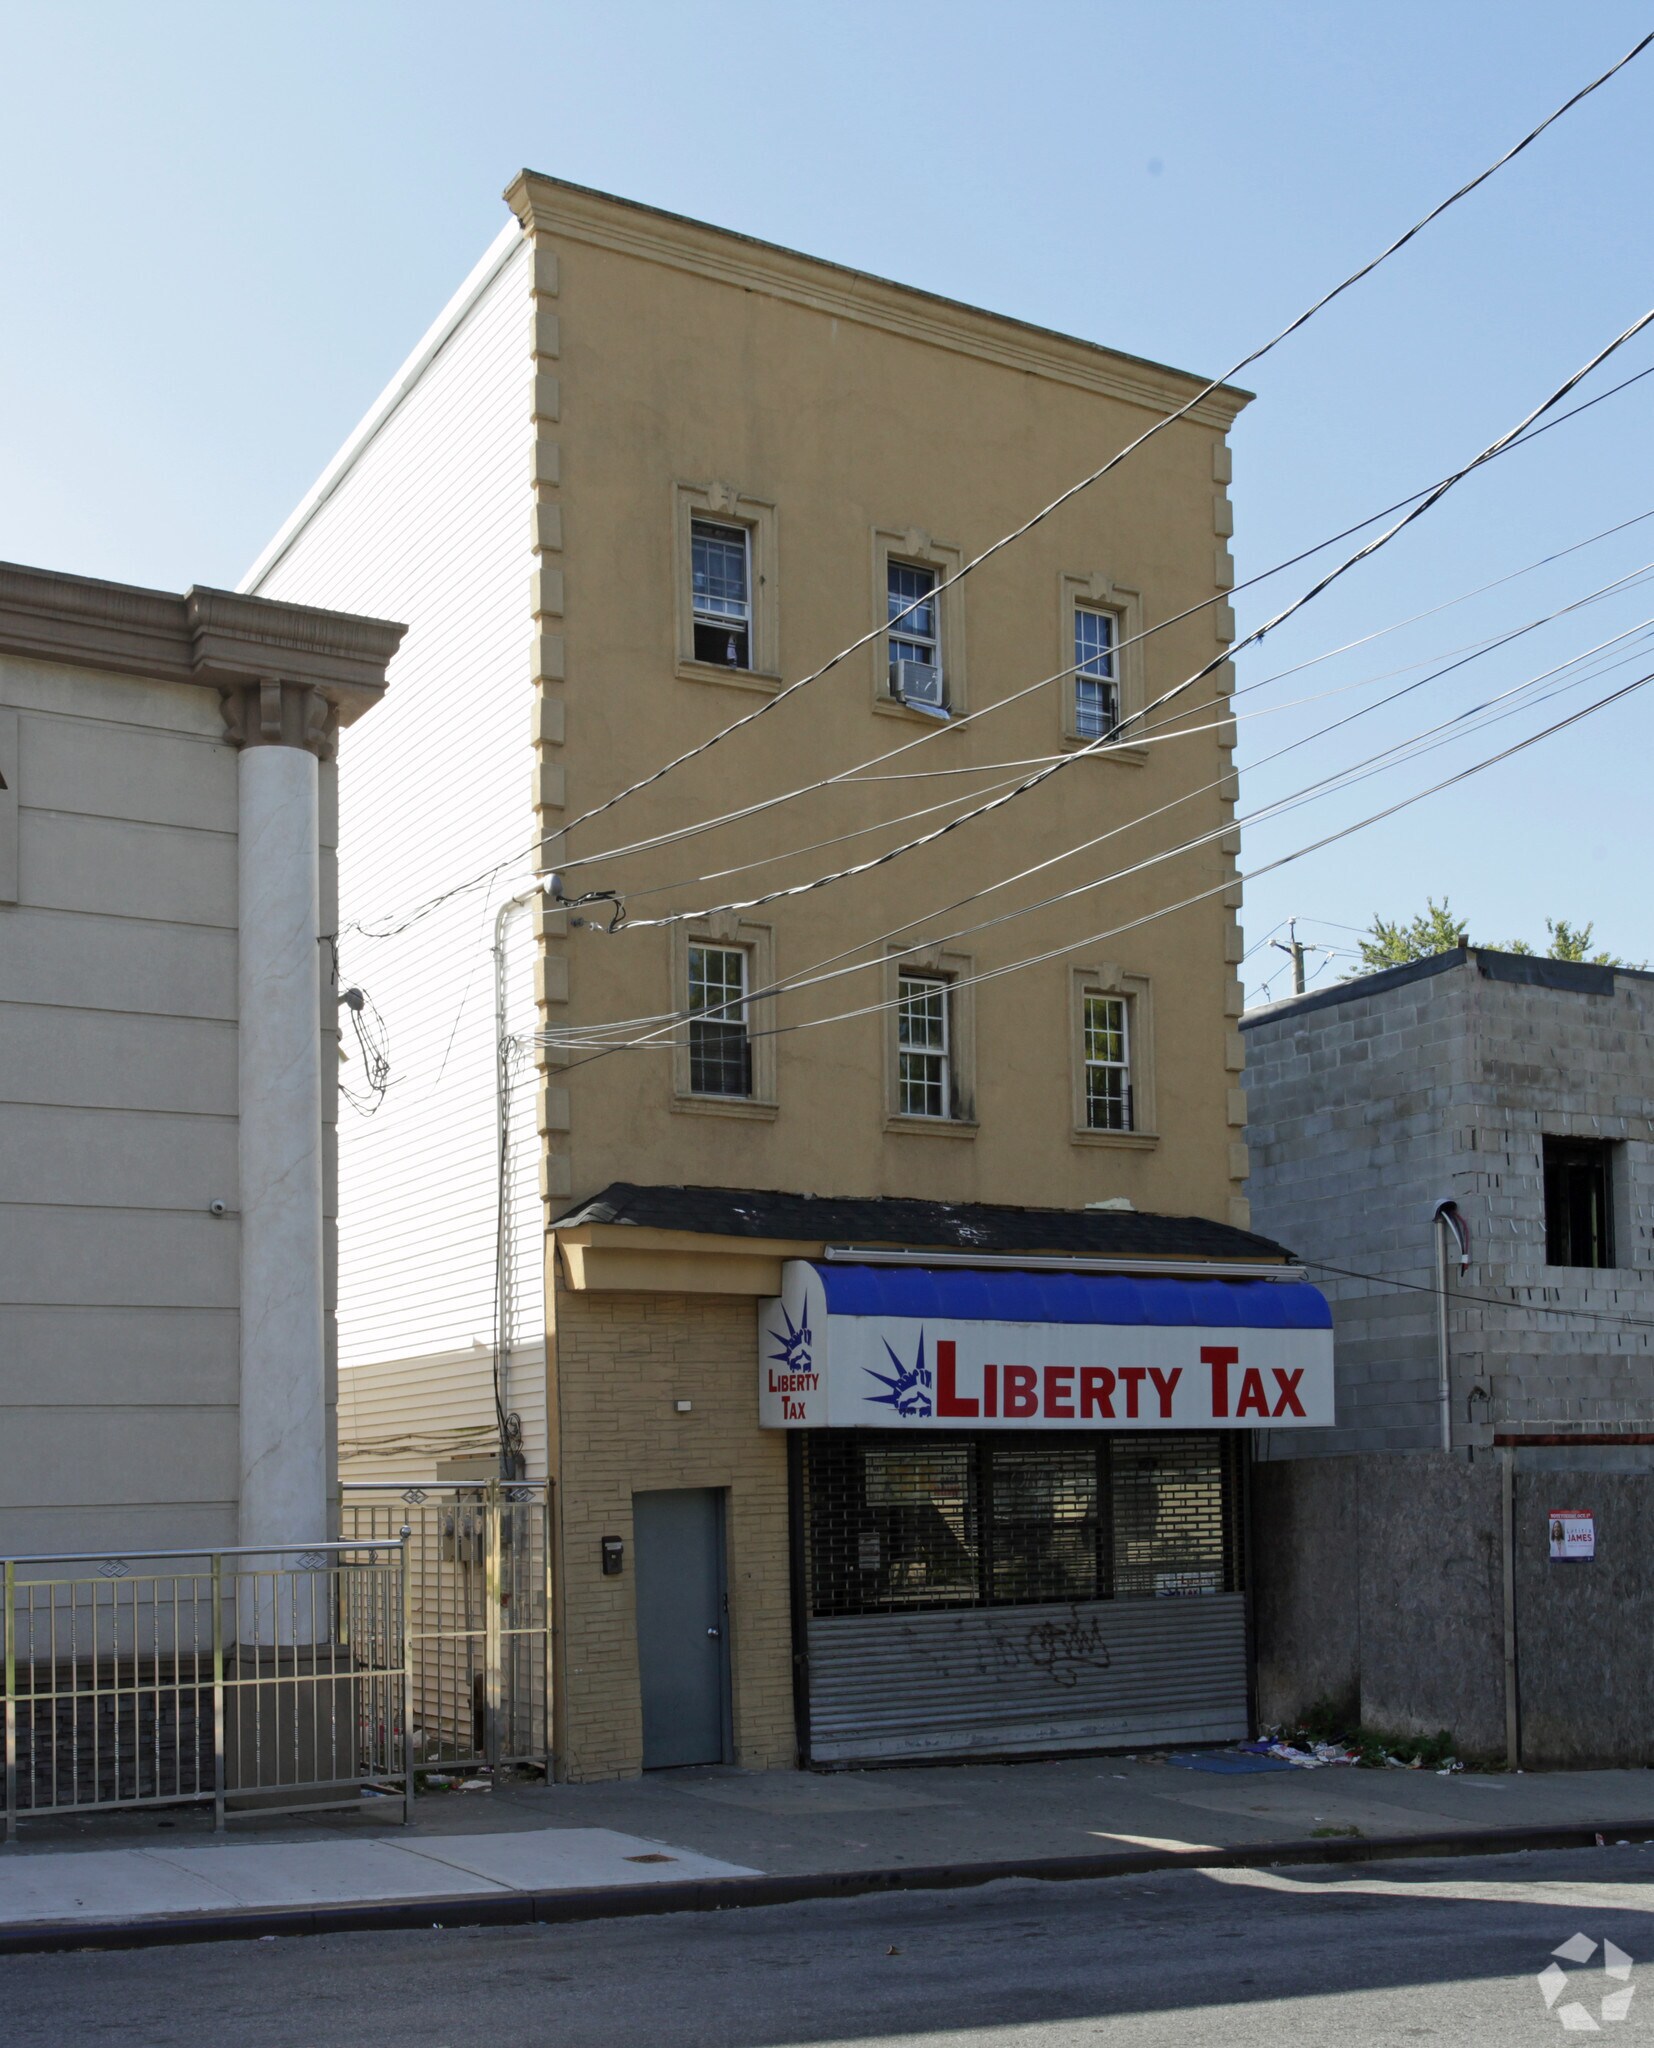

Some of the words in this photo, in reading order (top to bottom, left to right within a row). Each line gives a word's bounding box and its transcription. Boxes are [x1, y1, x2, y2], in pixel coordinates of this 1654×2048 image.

[768, 1368, 819, 1393] LIBERTY
[936, 1340, 1182, 1418] LIBERTY
[1200, 1346, 1306, 1417] TAX
[781, 1396, 806, 1420] TAX
[1567, 1533, 1592, 1542] JAMES
